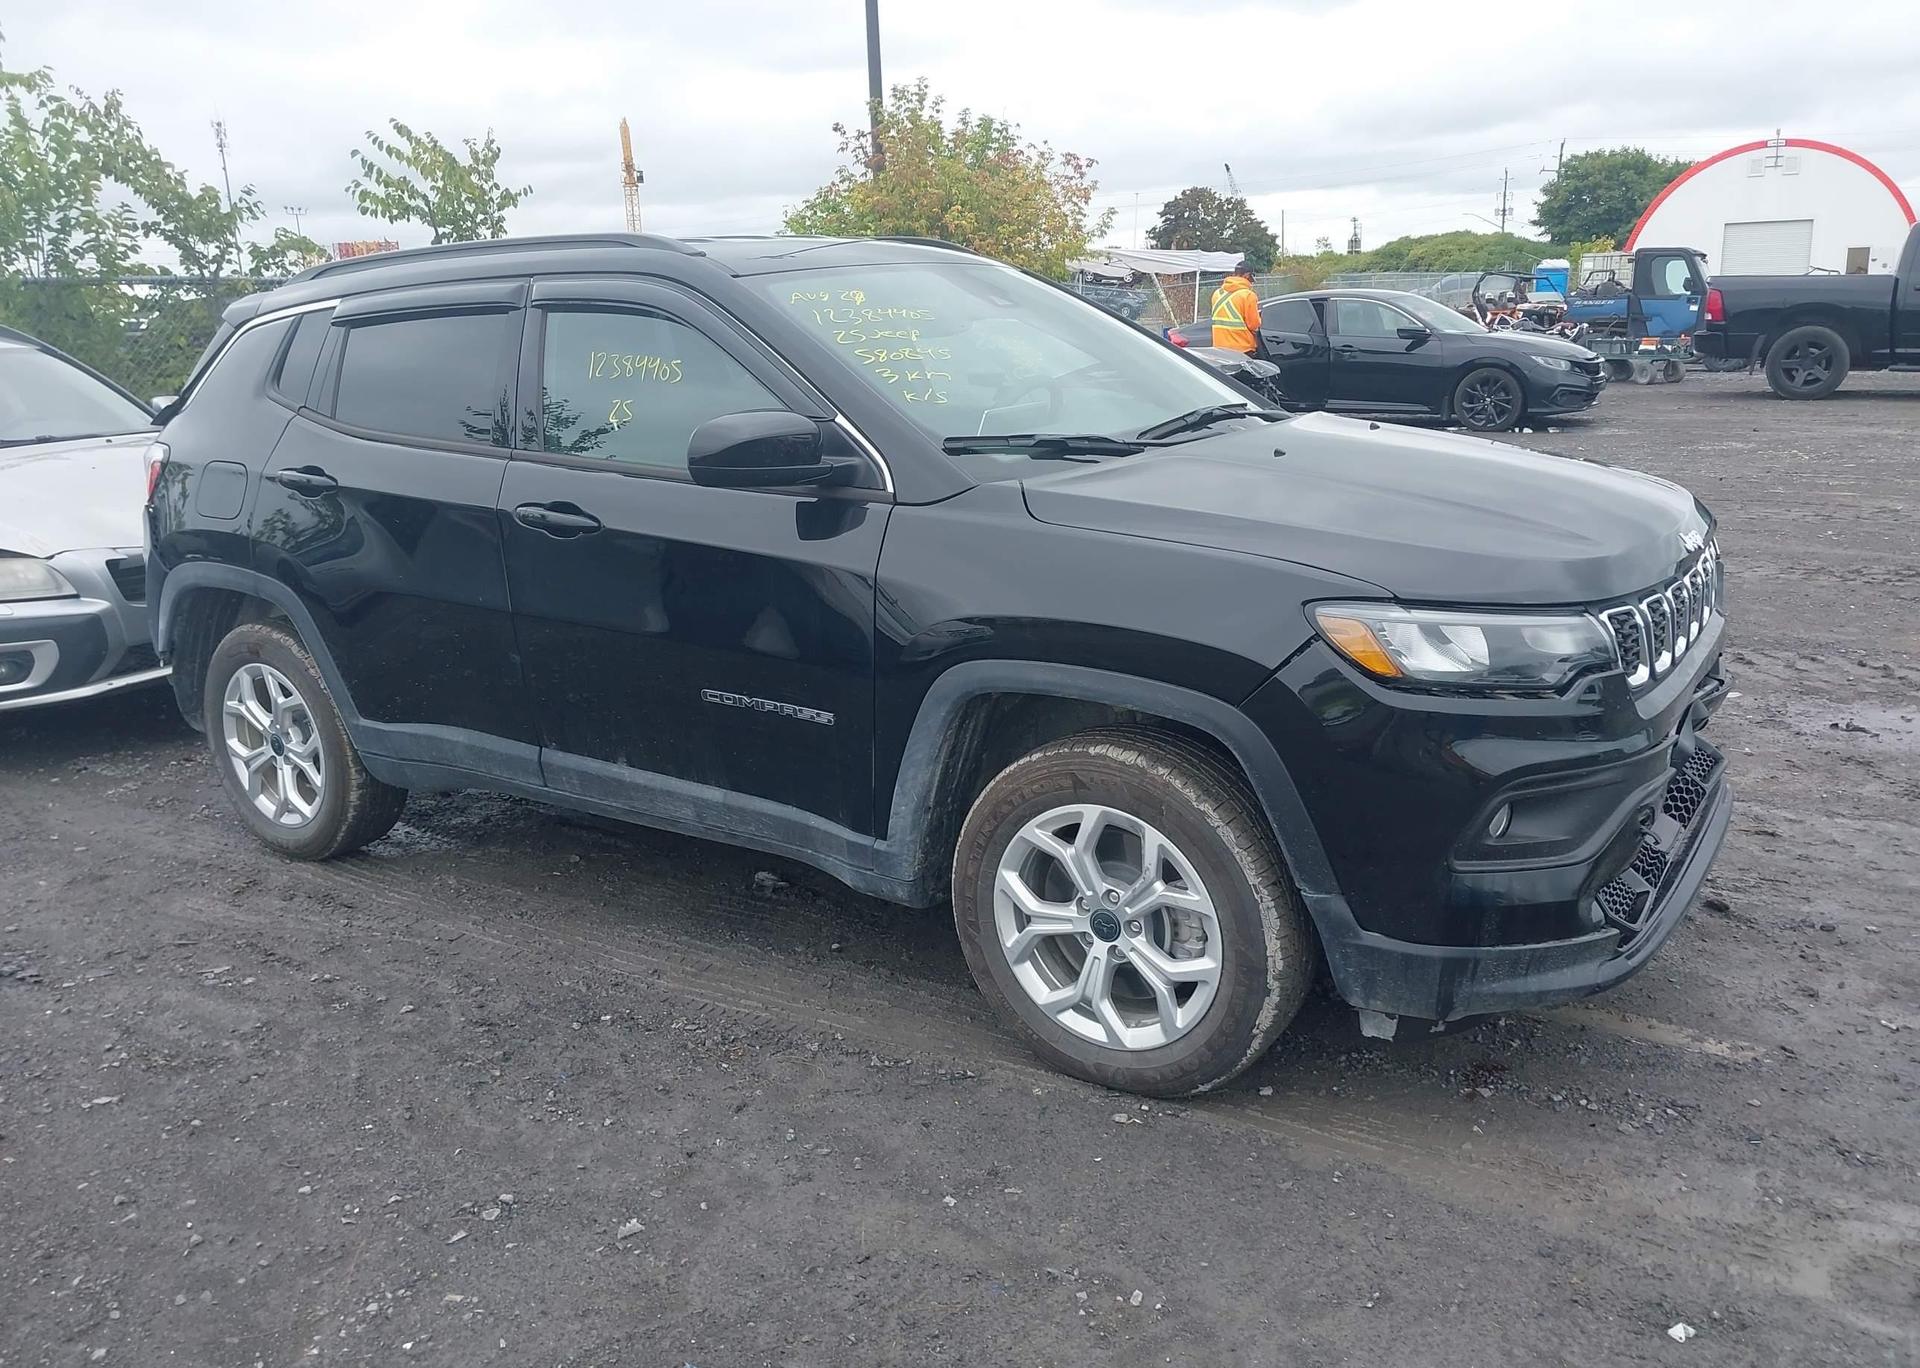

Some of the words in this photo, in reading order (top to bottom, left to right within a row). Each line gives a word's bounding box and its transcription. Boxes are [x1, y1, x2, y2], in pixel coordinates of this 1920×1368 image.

[833, 330, 866, 344] 25
[588, 351, 683, 384] 12384405
[609, 399, 633, 421] 25
[701, 689, 836, 725] COMPASS
